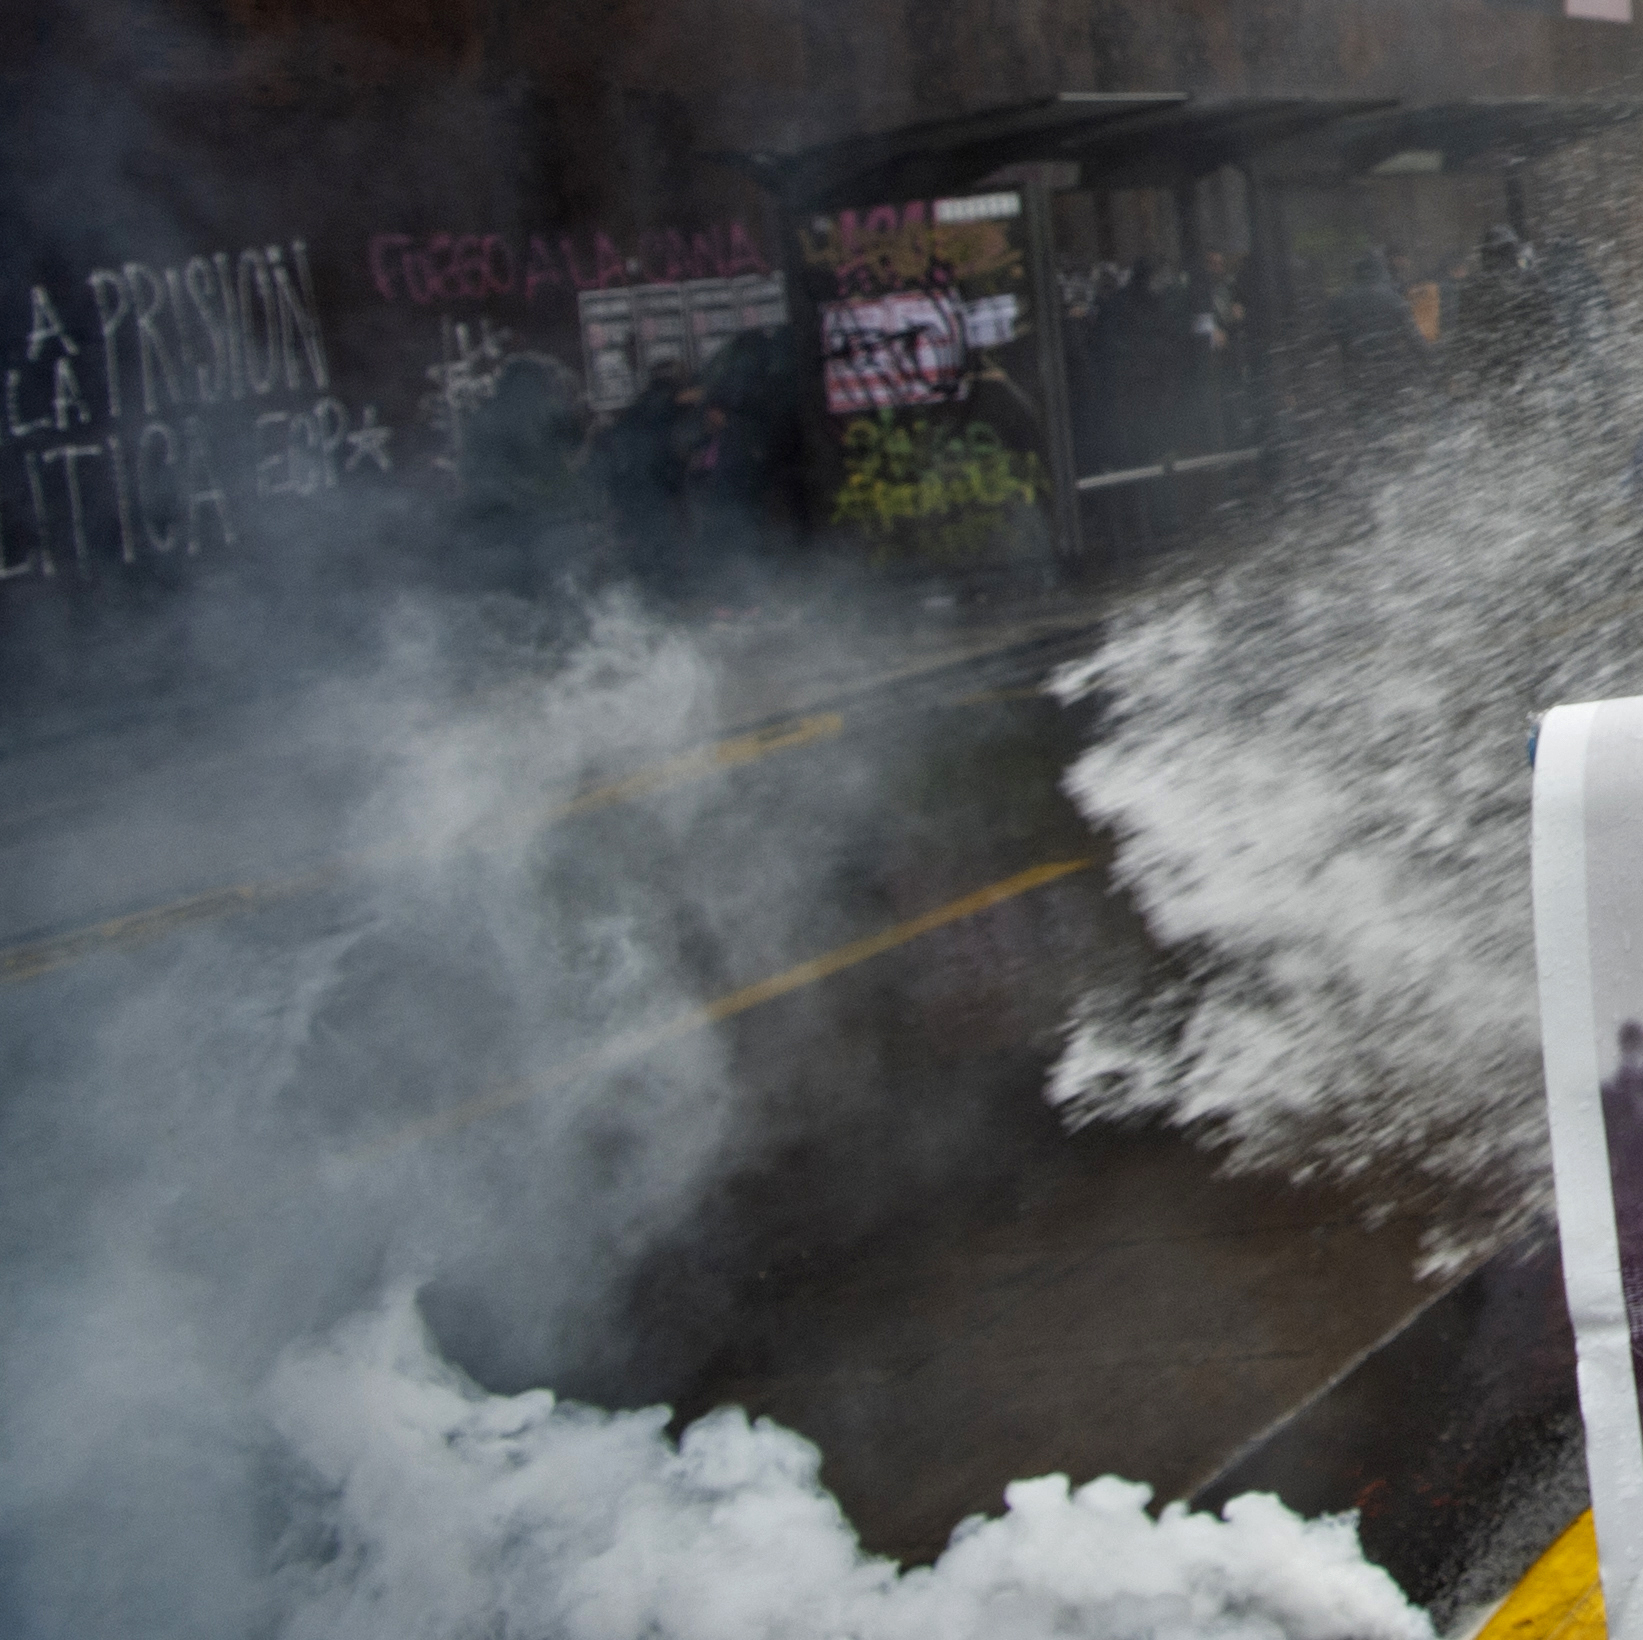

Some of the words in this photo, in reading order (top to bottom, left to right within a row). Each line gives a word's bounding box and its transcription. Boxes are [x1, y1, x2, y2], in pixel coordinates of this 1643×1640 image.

[368, 232, 517, 303] FUEGO
[524, 235, 562, 302] A
[557, 229, 631, 290] LA
[26, 284, 80, 362] A
[4, 357, 92, 438] LA
